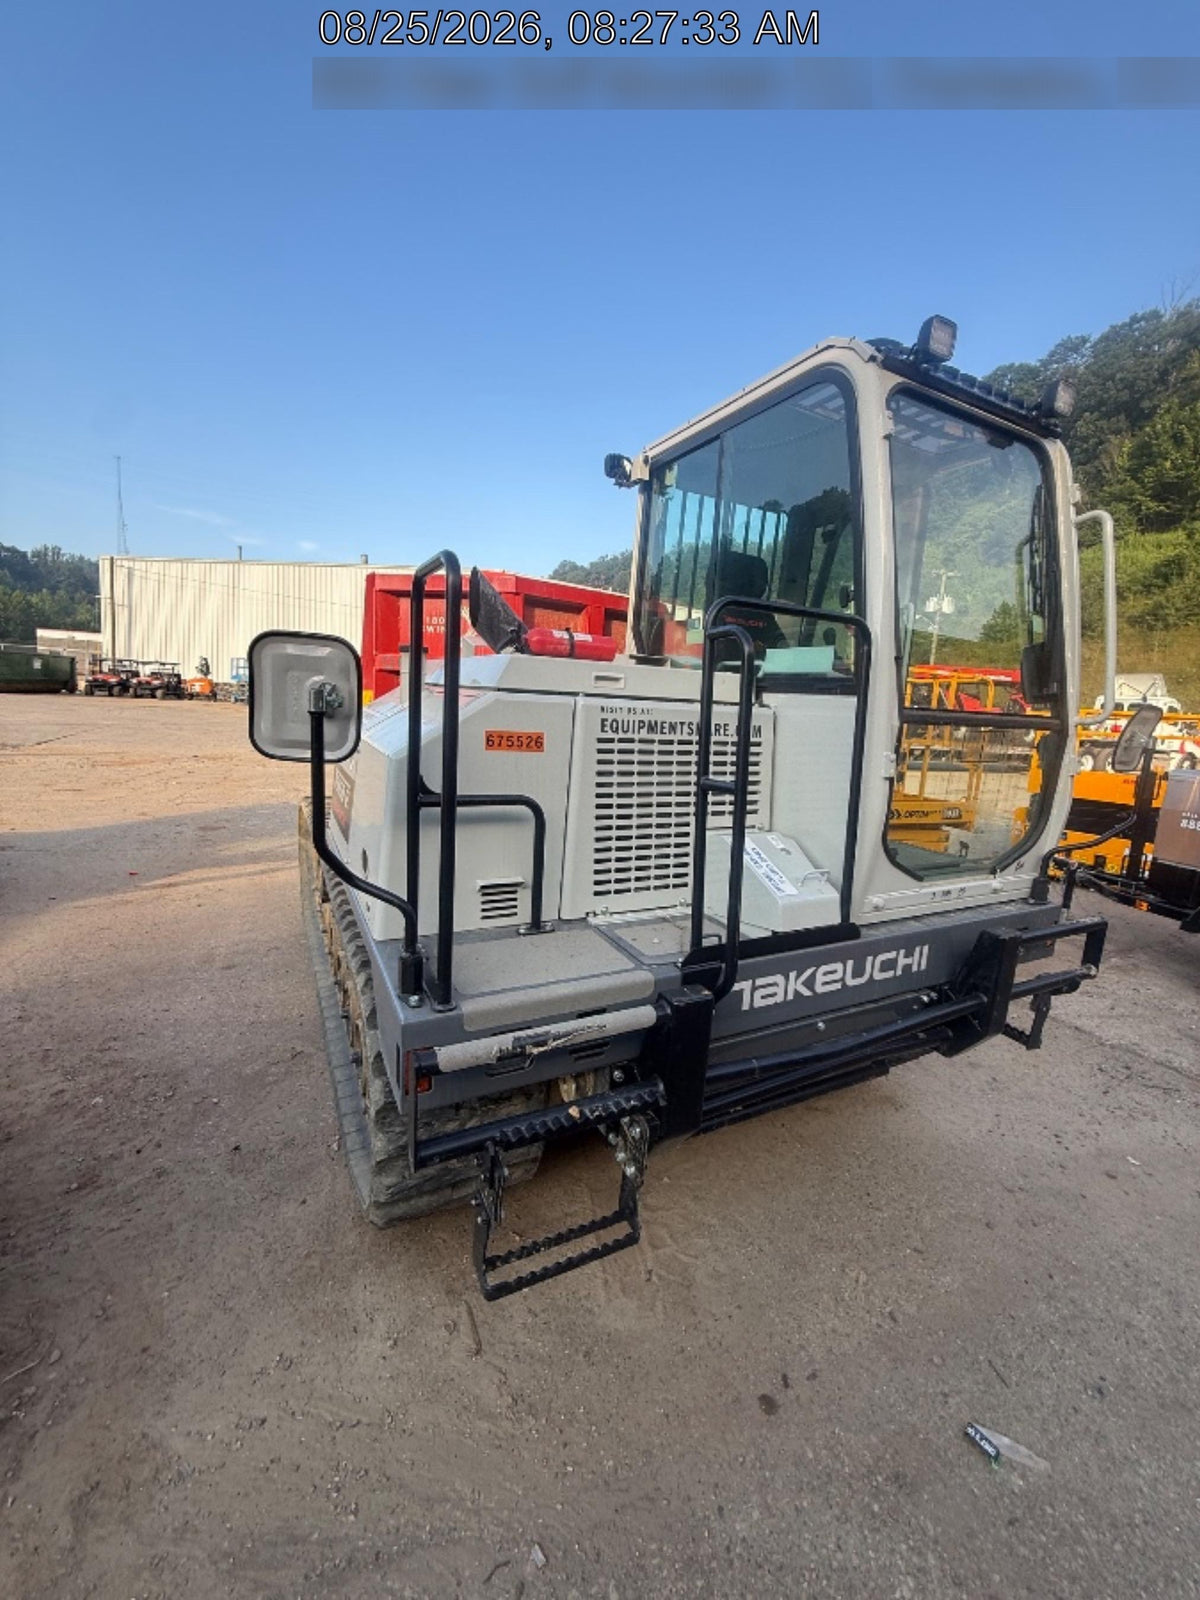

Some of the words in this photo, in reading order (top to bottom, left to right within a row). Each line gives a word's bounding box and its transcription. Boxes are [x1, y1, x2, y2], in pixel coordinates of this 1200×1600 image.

[600, 717, 763, 738] EQUIPMENTSRE.M
[486, 734, 543, 749] 675526
[731, 944, 929, 1011] TAKEUCHI
